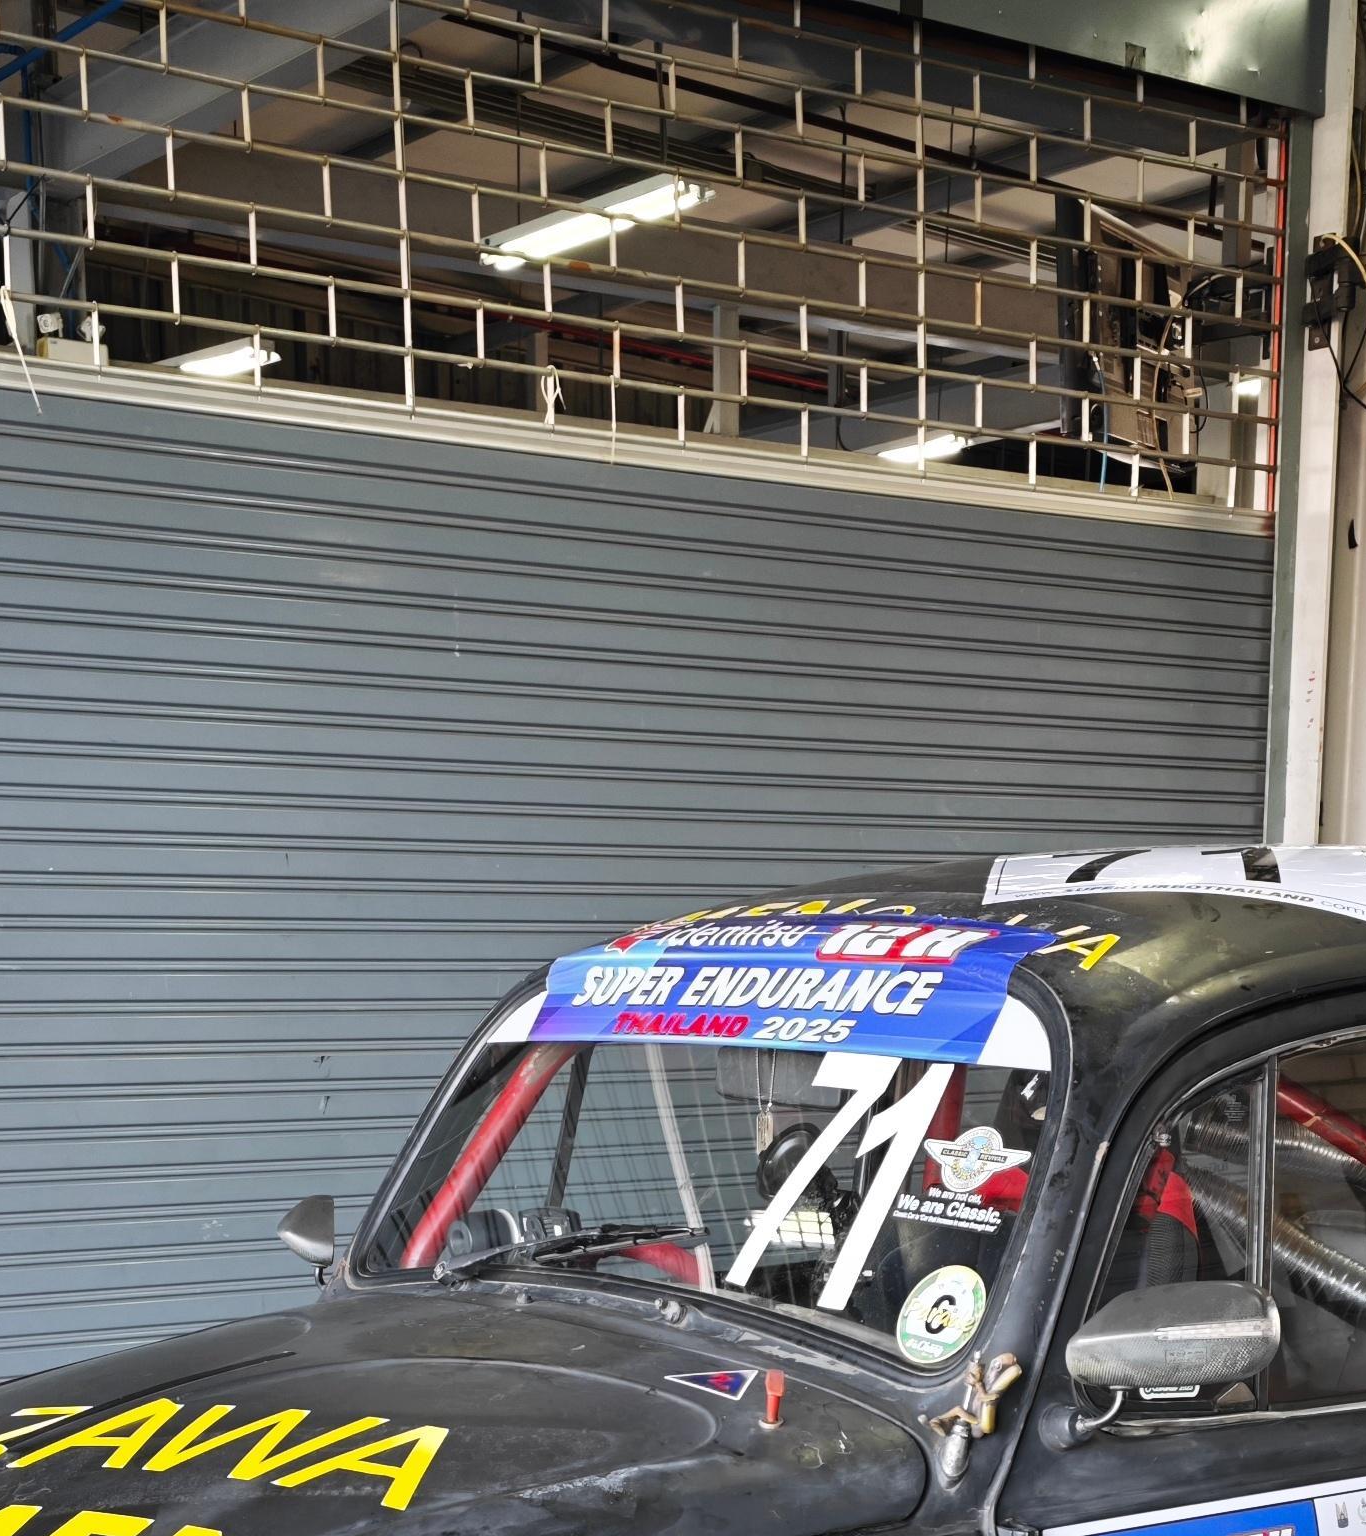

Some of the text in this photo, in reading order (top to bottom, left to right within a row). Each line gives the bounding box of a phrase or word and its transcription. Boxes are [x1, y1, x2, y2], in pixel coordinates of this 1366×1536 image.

[656, 919, 813, 948] idemitsu
[572, 966, 943, 1016] SUPER ENDURANCE
[612, 1012, 856, 1043] THAILAND 2025
[725, 1051, 955, 1311] 71
[929, 1187, 942, 1198] We
[942, 1190, 954, 1199] are
[955, 1192, 968, 1201] not
[897, 1194, 1002, 1225] We are Classic.
